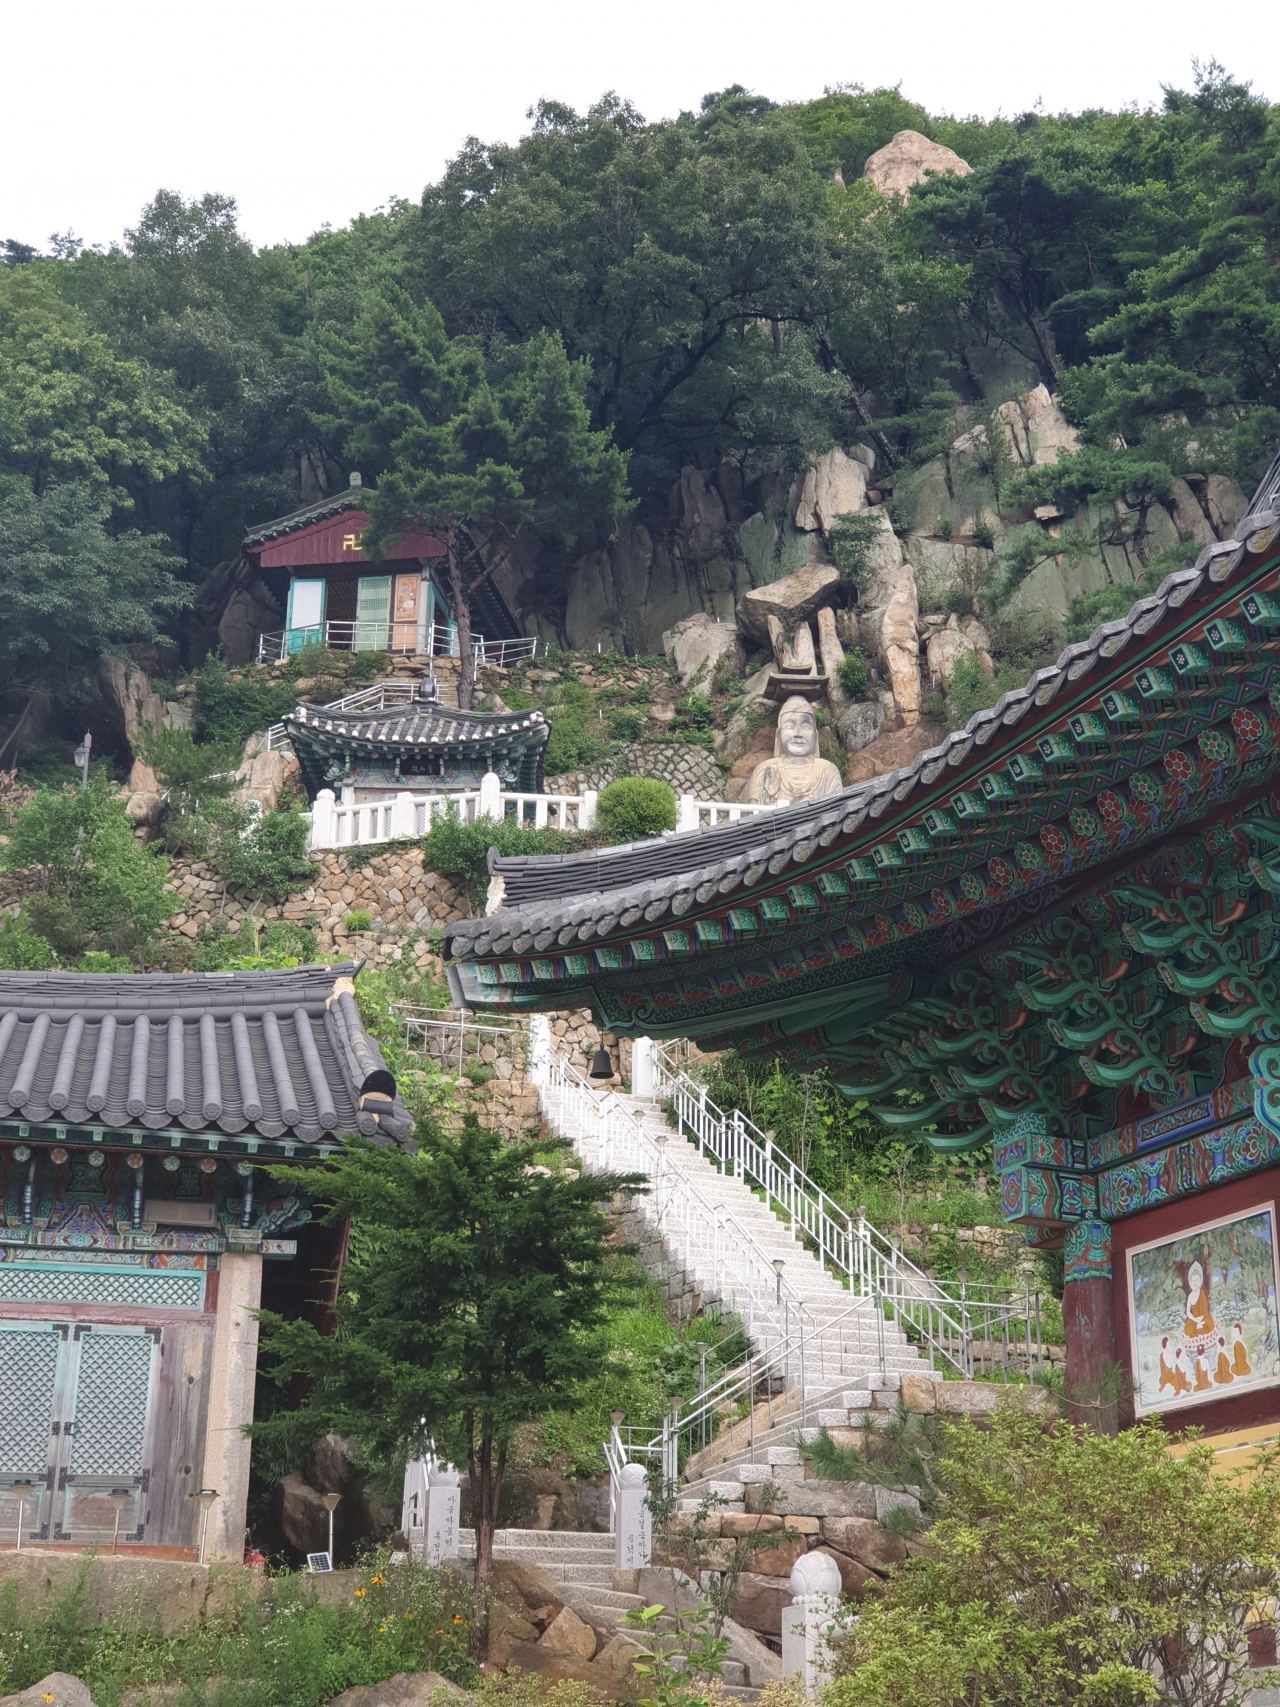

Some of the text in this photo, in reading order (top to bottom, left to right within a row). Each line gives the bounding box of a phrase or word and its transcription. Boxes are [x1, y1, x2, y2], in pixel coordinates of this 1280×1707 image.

[444, 1495, 457, 1547] 마음마음이
[432, 1530, 441, 1570] 복전이
[626, 1533, 635, 1569] 공덕이
